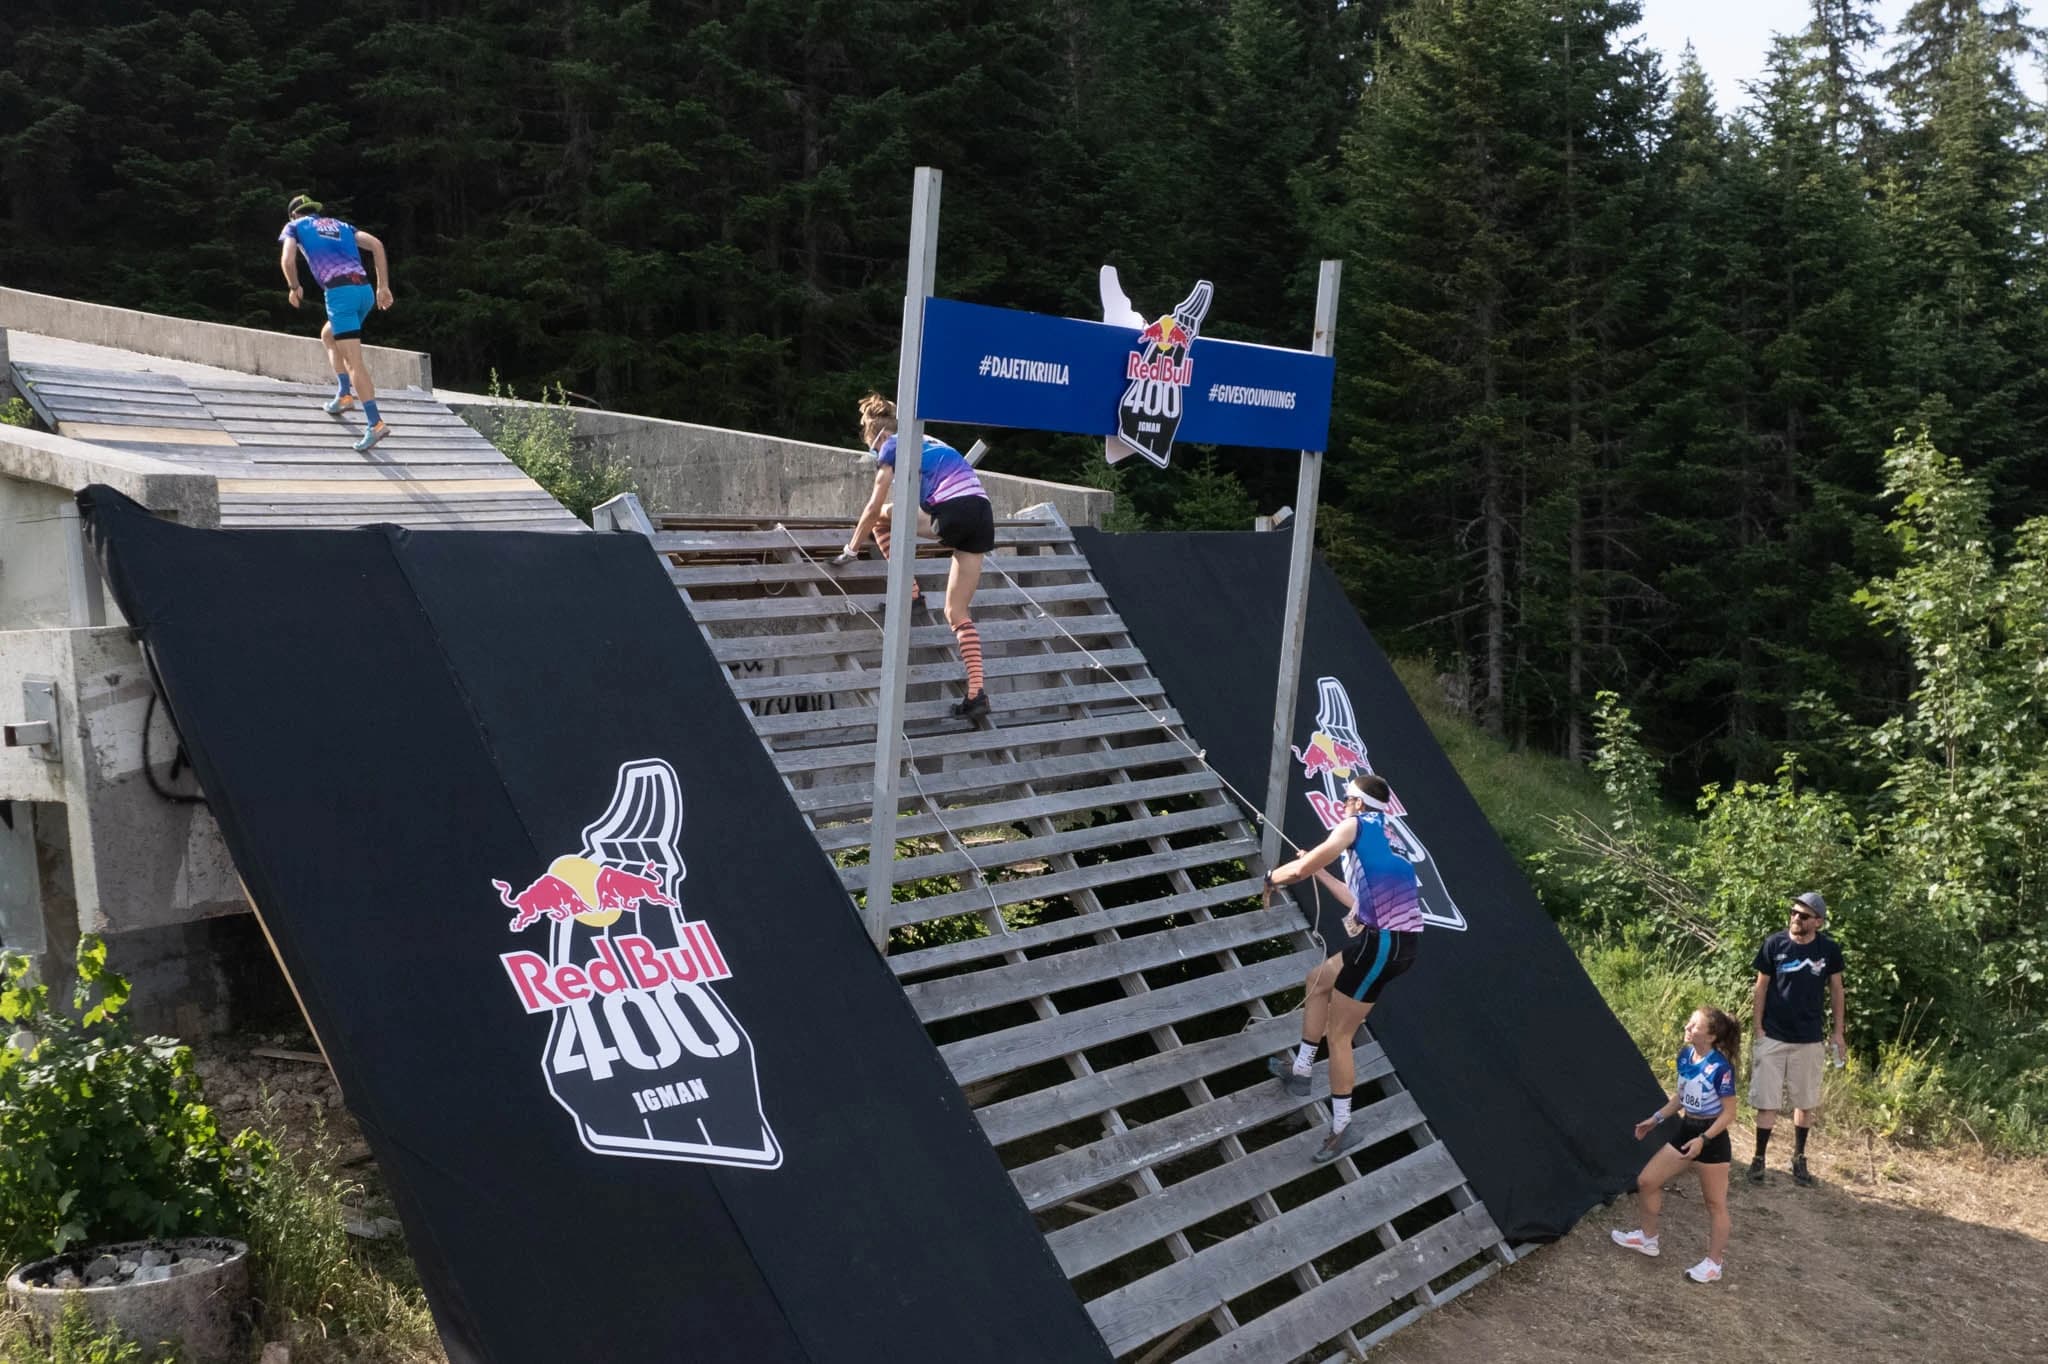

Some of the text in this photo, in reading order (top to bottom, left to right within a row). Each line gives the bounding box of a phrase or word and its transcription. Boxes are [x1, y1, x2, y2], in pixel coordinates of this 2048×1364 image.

[979, 355, 1069, 385] #DAJETIKRIIILA
[1128, 352, 1192, 386] Red Bull
[1124, 380, 1180, 418] 400
[1208, 384, 1297, 410] #GIVESYOUWIIINGS
[1138, 421, 1161, 433] IGMAN
[502, 922, 732, 1012] Red Bull
[553, 983, 740, 1081] 400
[632, 1078, 709, 1114] IGMAN
